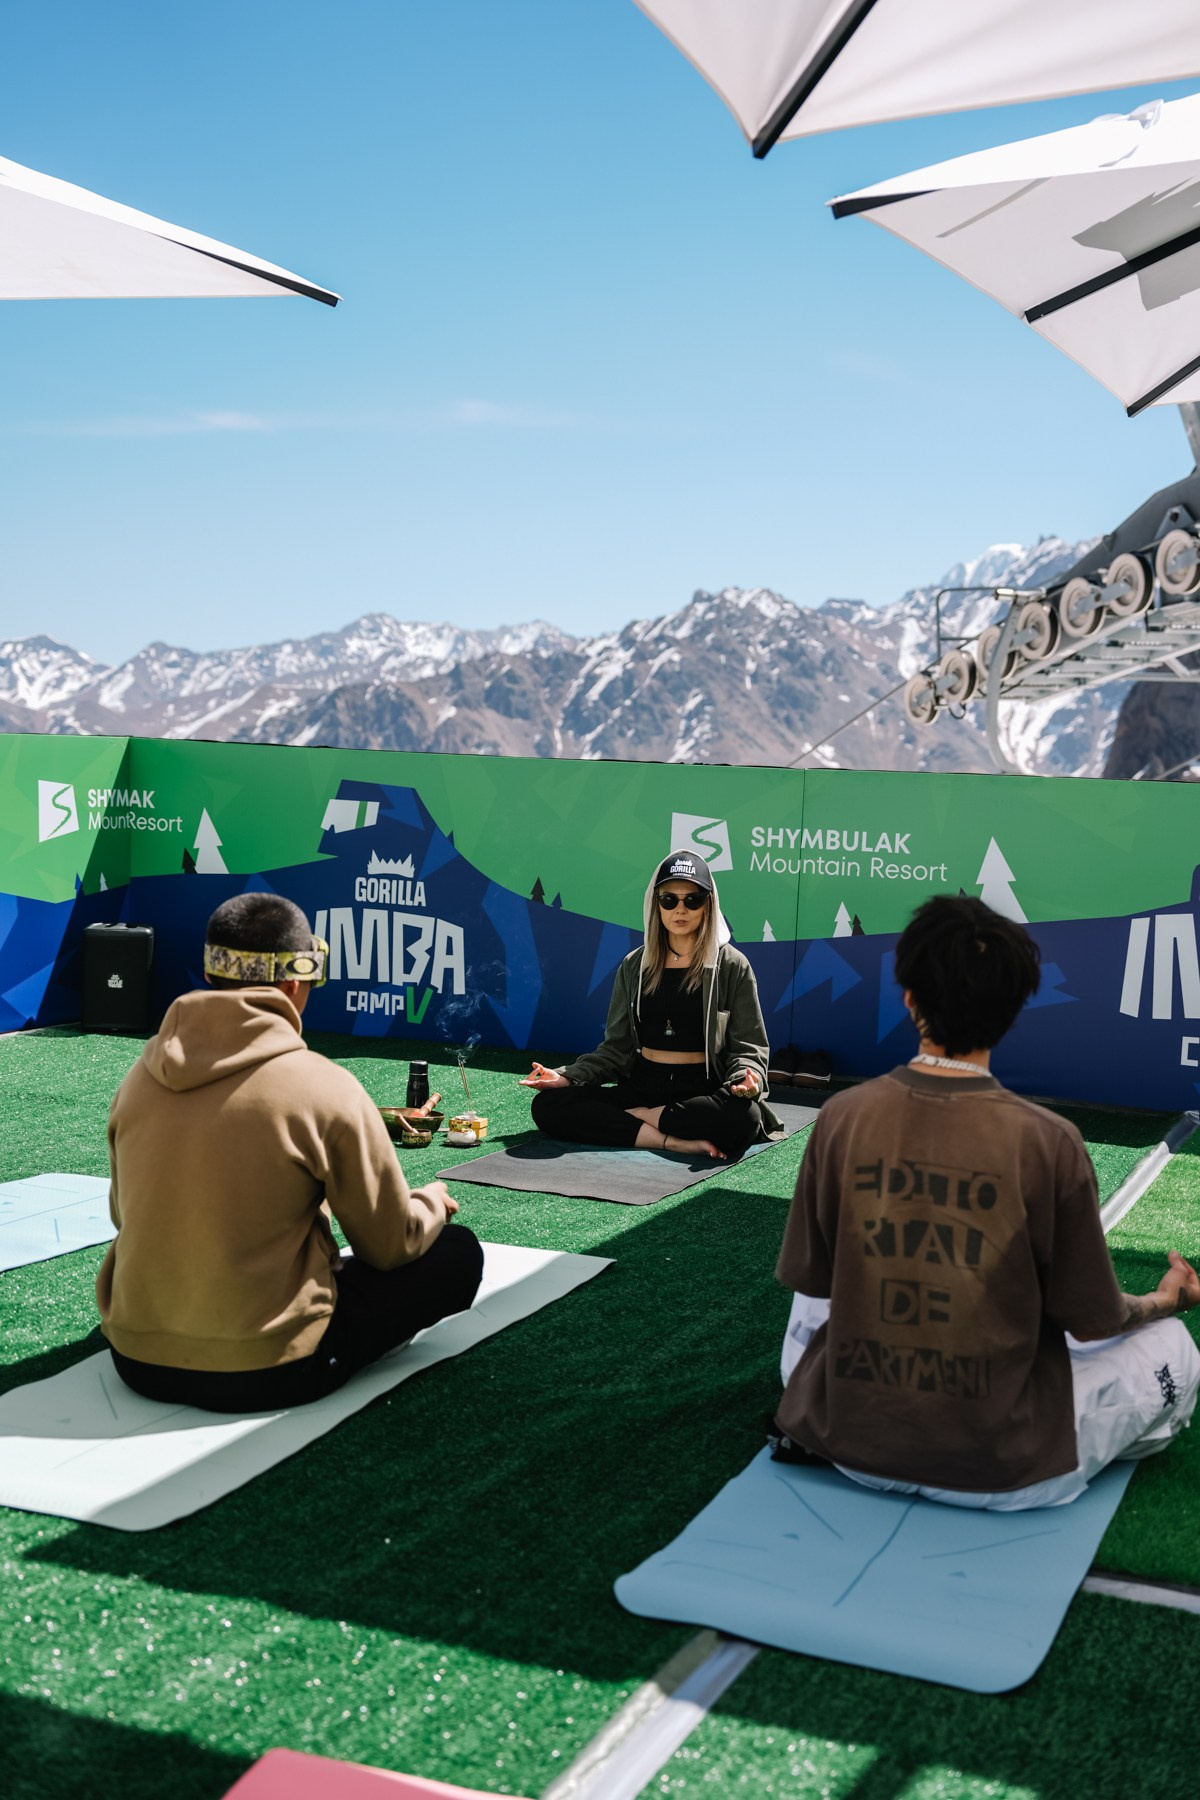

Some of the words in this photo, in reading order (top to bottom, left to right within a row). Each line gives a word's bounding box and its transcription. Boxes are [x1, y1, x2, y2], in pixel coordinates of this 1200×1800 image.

[87, 788, 155, 809] SHYMAK
[750, 826, 911, 855] SHYMBULAK
[670, 865, 696, 875] GORILLA
[749, 851, 860, 877] Mountain
[870, 857, 948, 882] Resort
[354, 876, 427, 907] GORILLA
[881, 1278, 951, 1327] DE
